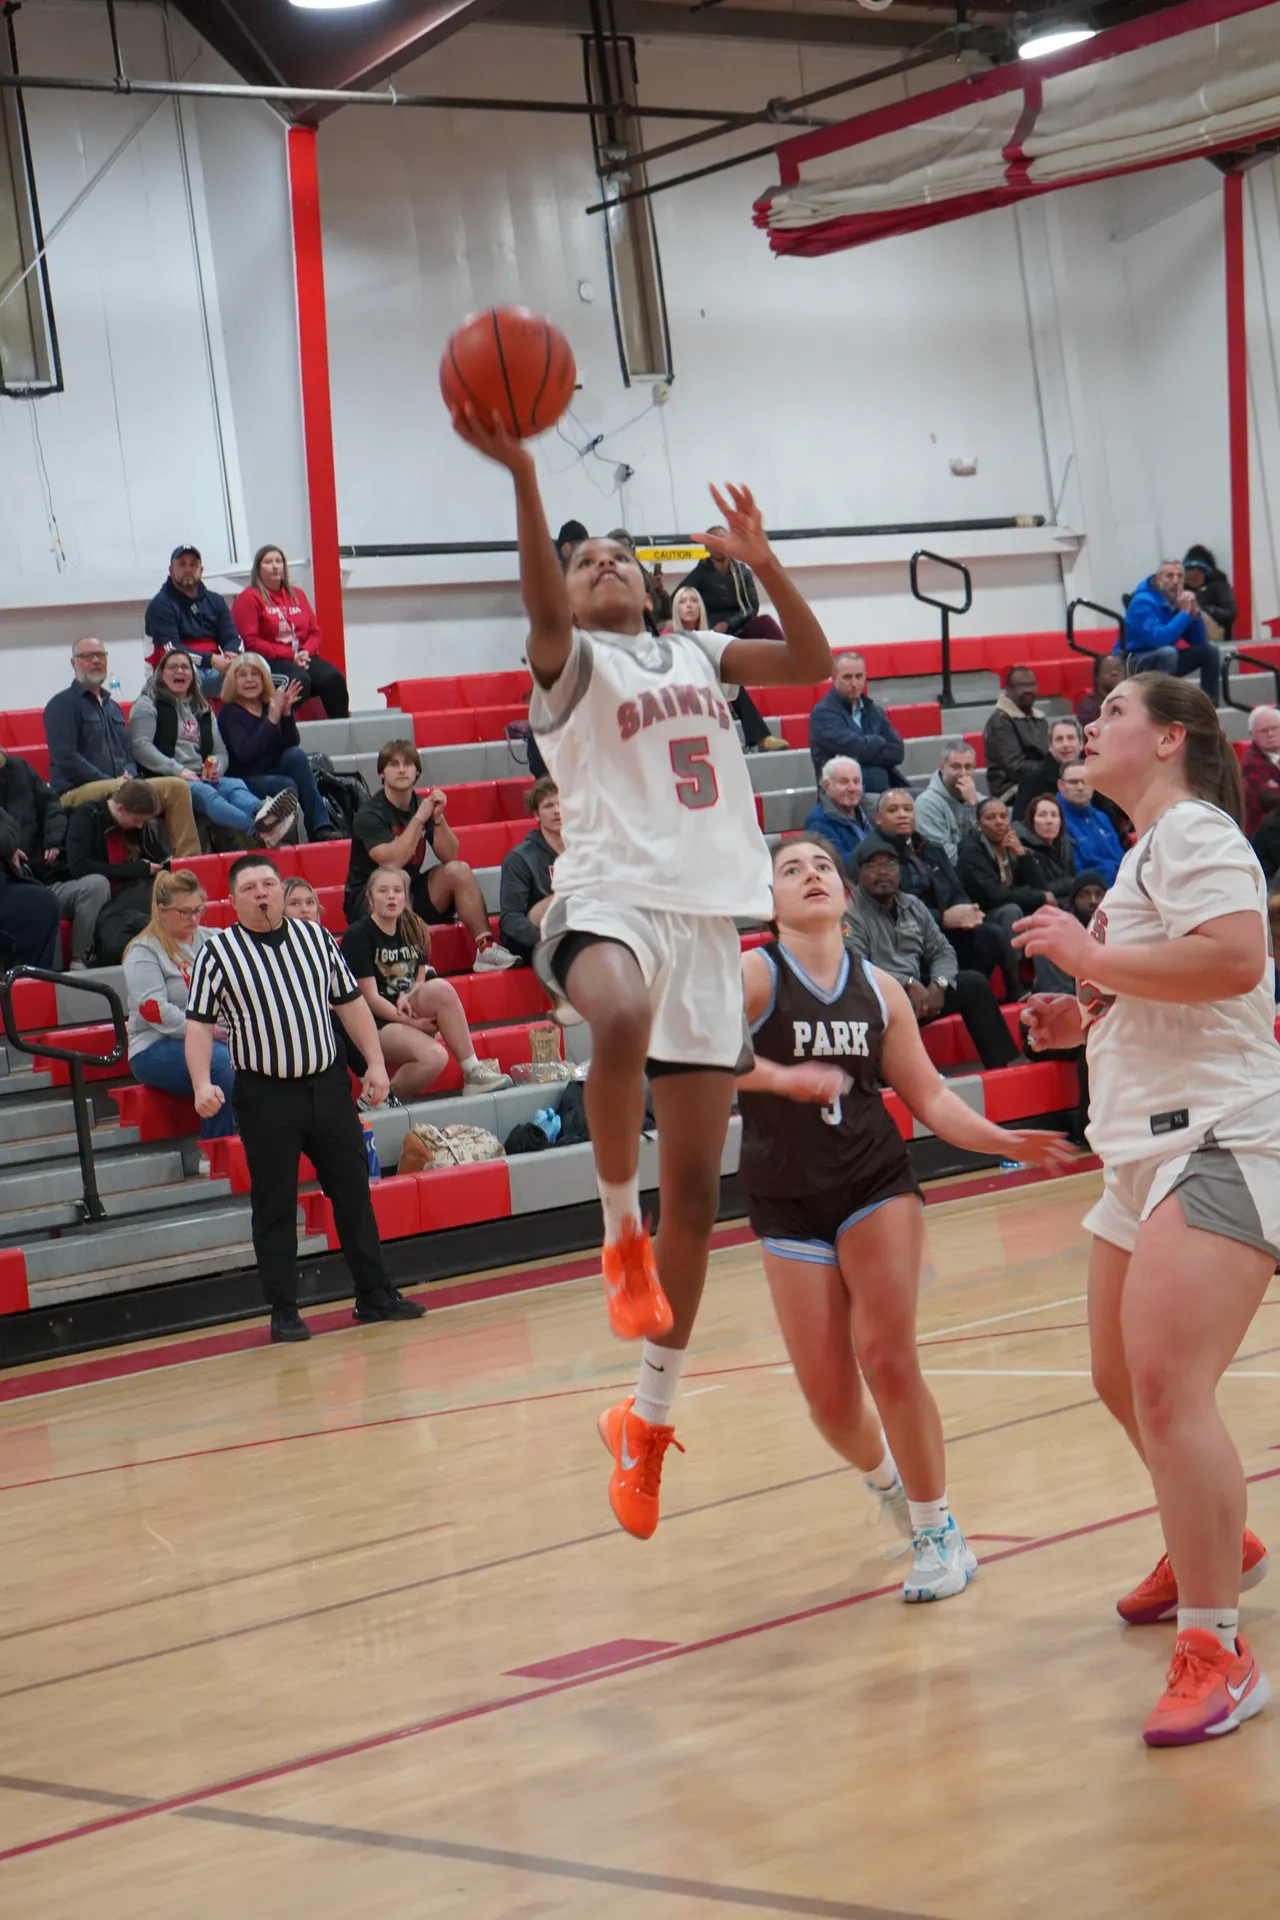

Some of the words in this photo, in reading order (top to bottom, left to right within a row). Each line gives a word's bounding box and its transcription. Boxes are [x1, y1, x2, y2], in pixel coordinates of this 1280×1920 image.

[654, 550, 692, 560] CAUTION
[617, 684, 730, 741] SAINTS
[668, 735, 719, 810] 5
[374, 948, 380, 964] I
[381, 948, 399, 963] GOT
[793, 1021, 870, 1057] PARK
[1173, 1114, 1184, 1125] XL
